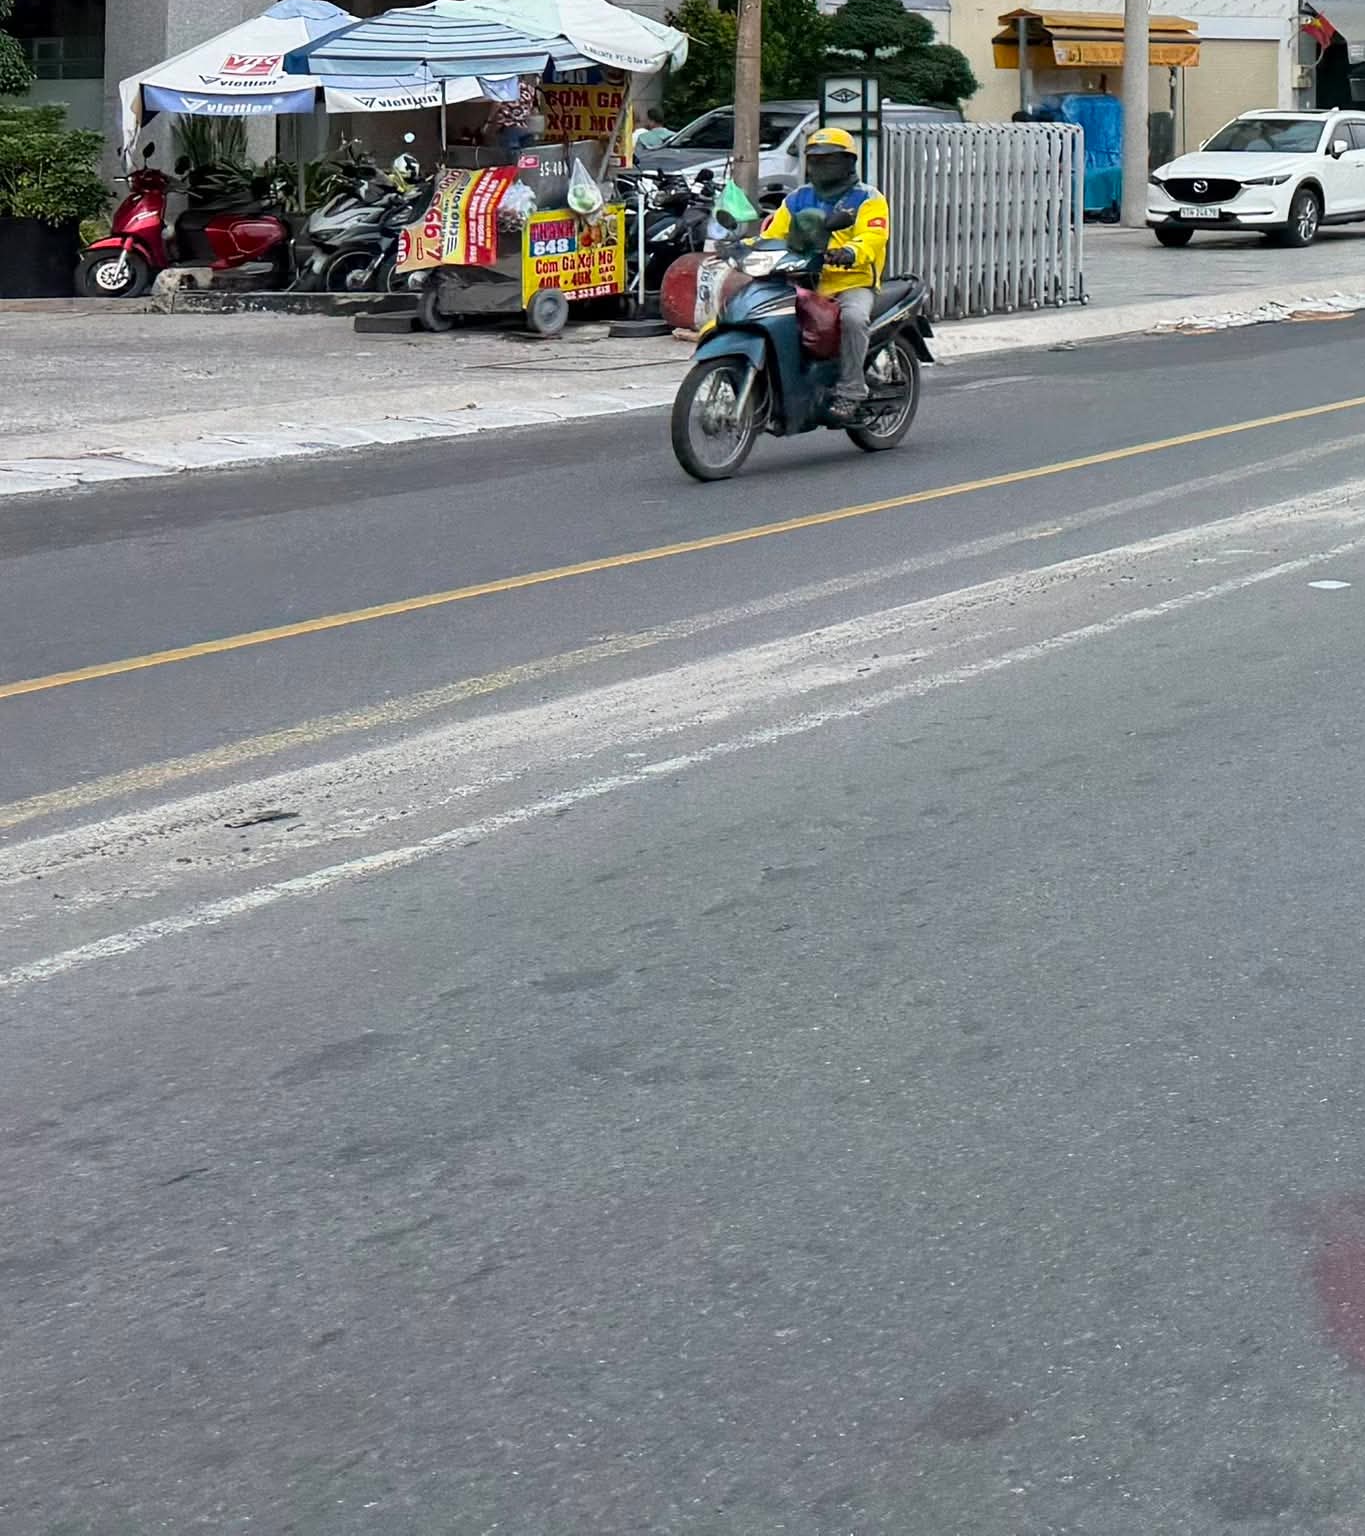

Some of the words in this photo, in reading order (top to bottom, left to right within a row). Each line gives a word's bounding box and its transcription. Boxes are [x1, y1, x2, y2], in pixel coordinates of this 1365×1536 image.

[533, 238, 570, 256] 648
[535, 258, 559, 275] Cơm
[562, 254, 576, 271] Gà
